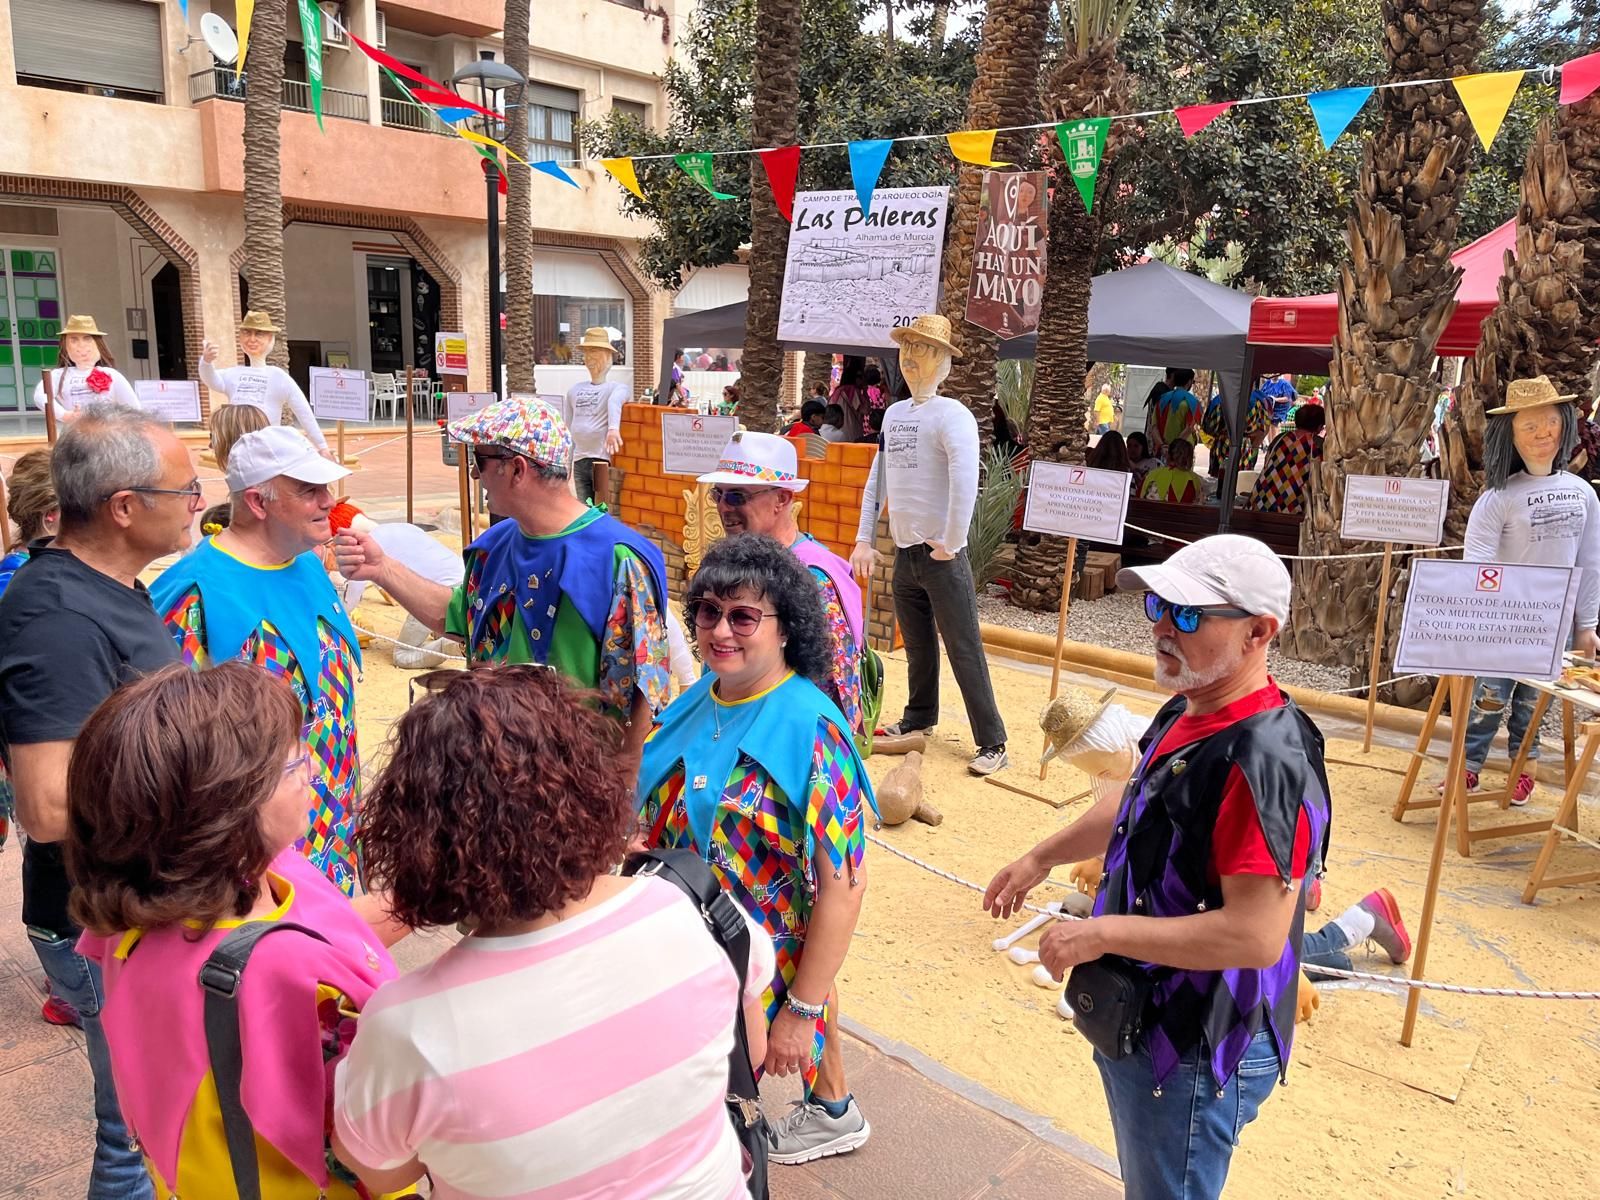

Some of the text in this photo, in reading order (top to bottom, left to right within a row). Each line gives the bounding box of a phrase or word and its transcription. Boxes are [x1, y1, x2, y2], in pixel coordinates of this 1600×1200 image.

[795, 206, 939, 232] Las Paleras
[856, 232, 934, 242] Alhama de Murcia
[982, 216, 1038, 254] AQUÍ
[976, 252, 1042, 276] HAY UN
[974, 272, 1041, 306] MAYO
[694, 420, 702, 430] 6
[1072, 470, 1084, 482] 7
[1054, 486, 1085, 494] BASTONES
[1387, 480, 1399, 492] 10
[1528, 496, 1544, 506] Las
[1480, 568, 1498, 589] 8
[1446, 596, 1482, 606] RESTOS
[1484, 598, 1498, 607] DE
[1502, 600, 1561, 610] ALHAMEÑOS
[1426, 608, 1545, 622] SON MULTICULTURALES,
[1418, 620, 1547, 634] ES QUE POR ESTAS TIERRAS
[1410, 632, 1433, 640] HAN
[1435, 633, 1474, 642] PASADO
[1476, 636, 1512, 645] MUCHA
